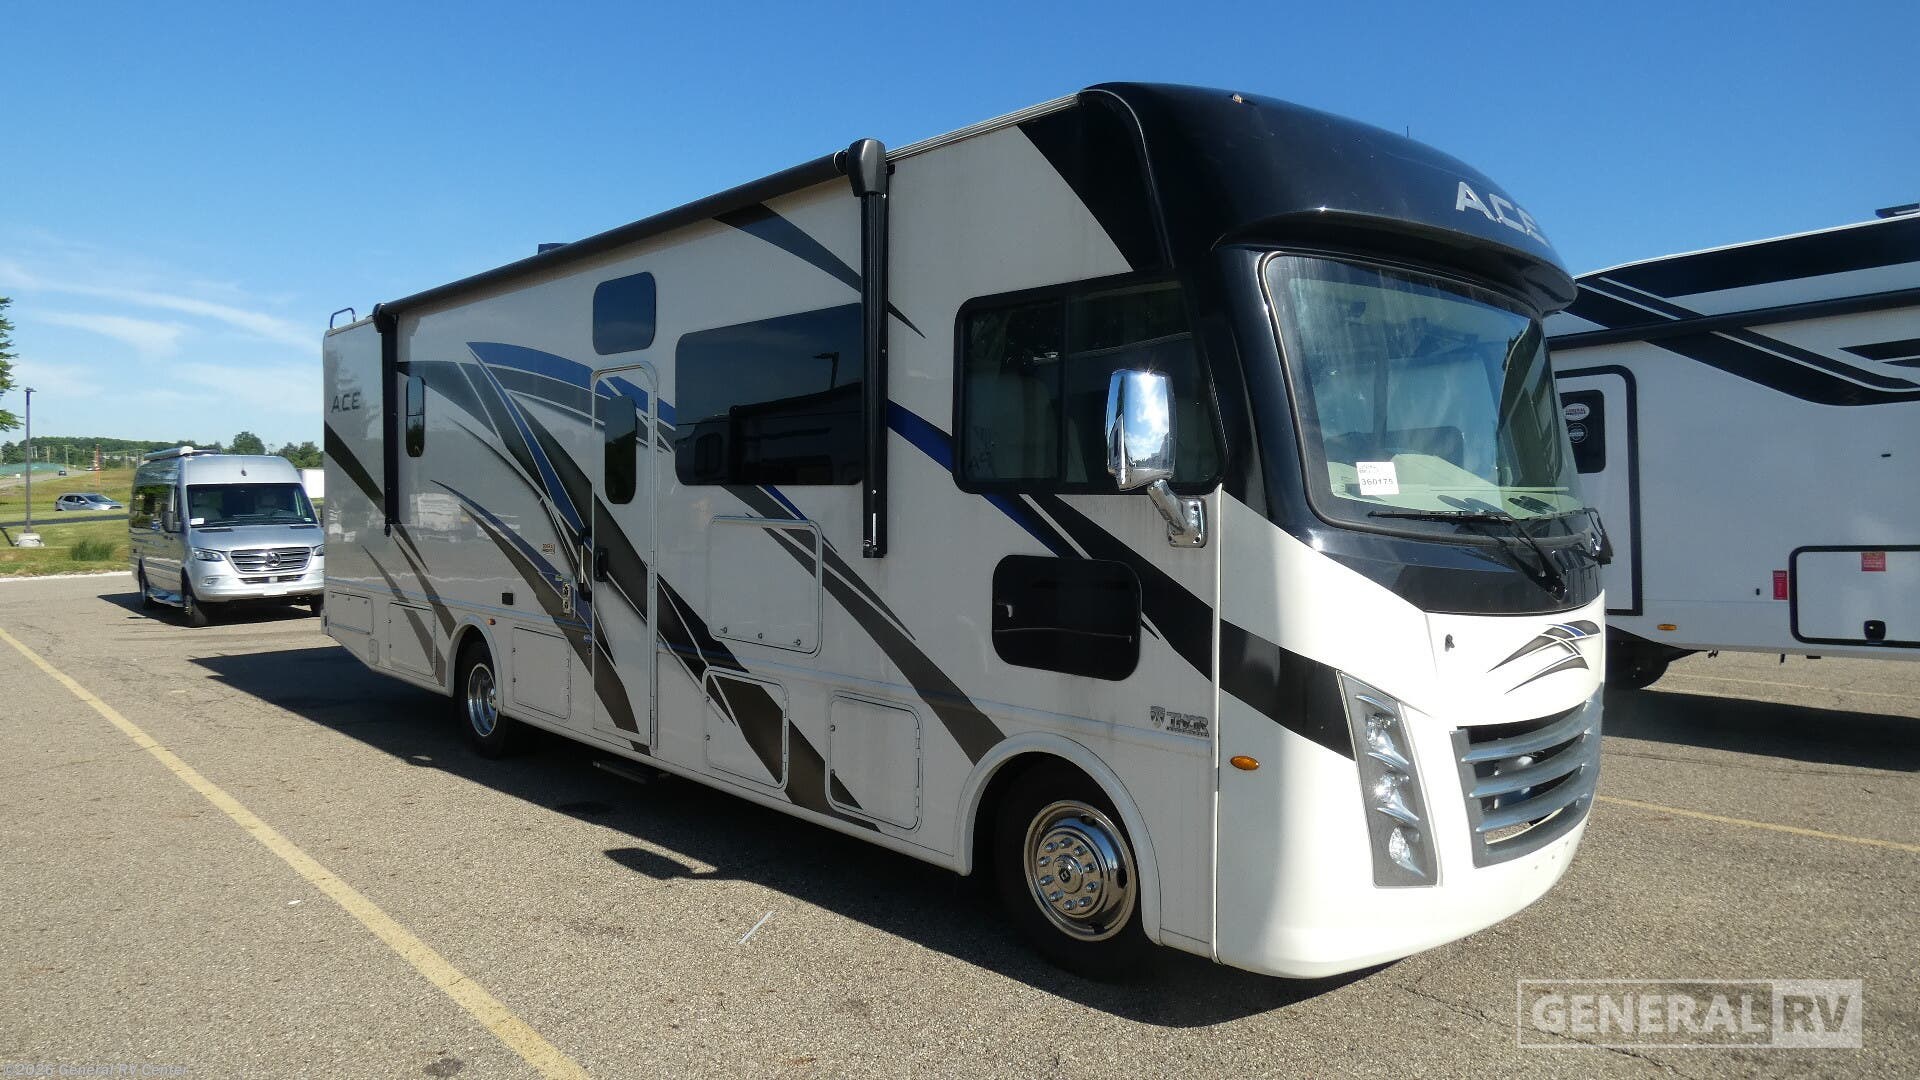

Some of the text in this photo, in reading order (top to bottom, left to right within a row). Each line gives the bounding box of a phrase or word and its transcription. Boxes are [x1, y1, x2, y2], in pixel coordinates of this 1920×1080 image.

[1455, 181, 1551, 248] ACE
[330, 391, 361, 413] ACE
[1360, 478, 1394, 486] 360175
